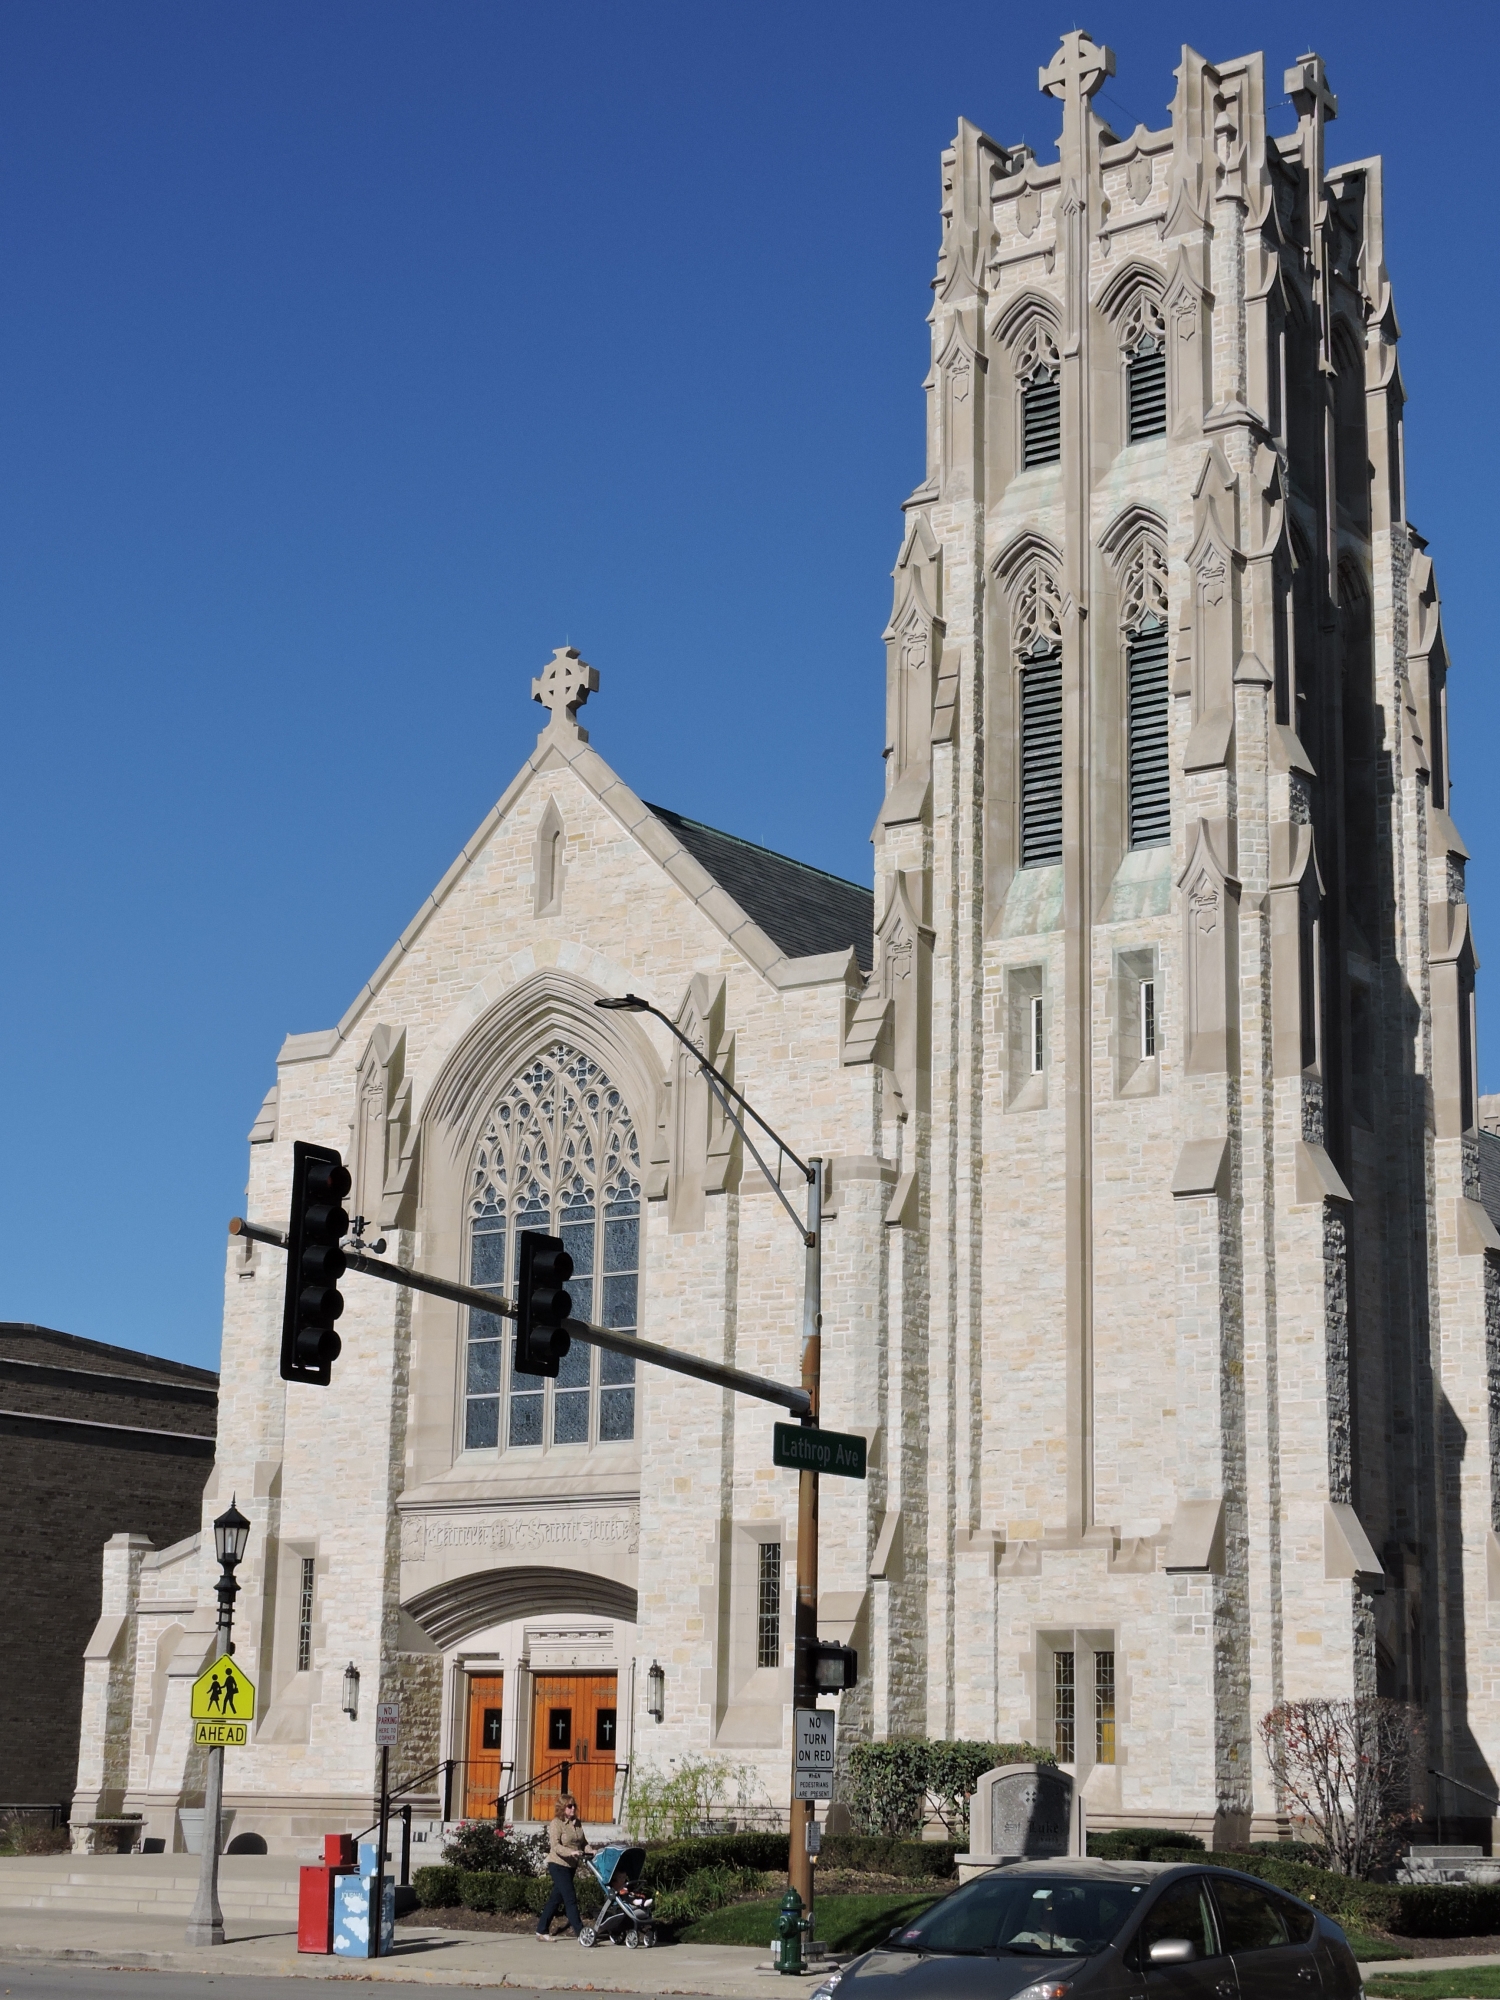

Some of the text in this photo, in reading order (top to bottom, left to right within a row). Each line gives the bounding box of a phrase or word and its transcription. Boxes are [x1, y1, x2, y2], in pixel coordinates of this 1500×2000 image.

[782, 1434, 859, 1468] Lathrop Ave
[383, 1707, 393, 1715] NO
[378, 1716, 398, 1725] PARKING
[809, 1717, 821, 1728] NO
[198, 1726, 244, 1742] AHEAD
[803, 1733, 827, 1745] TURN
[798, 1750, 831, 1761] ON RED
[810, 1790, 830, 1798] PRESENT
[1027, 1820, 1059, 1835] Luke
